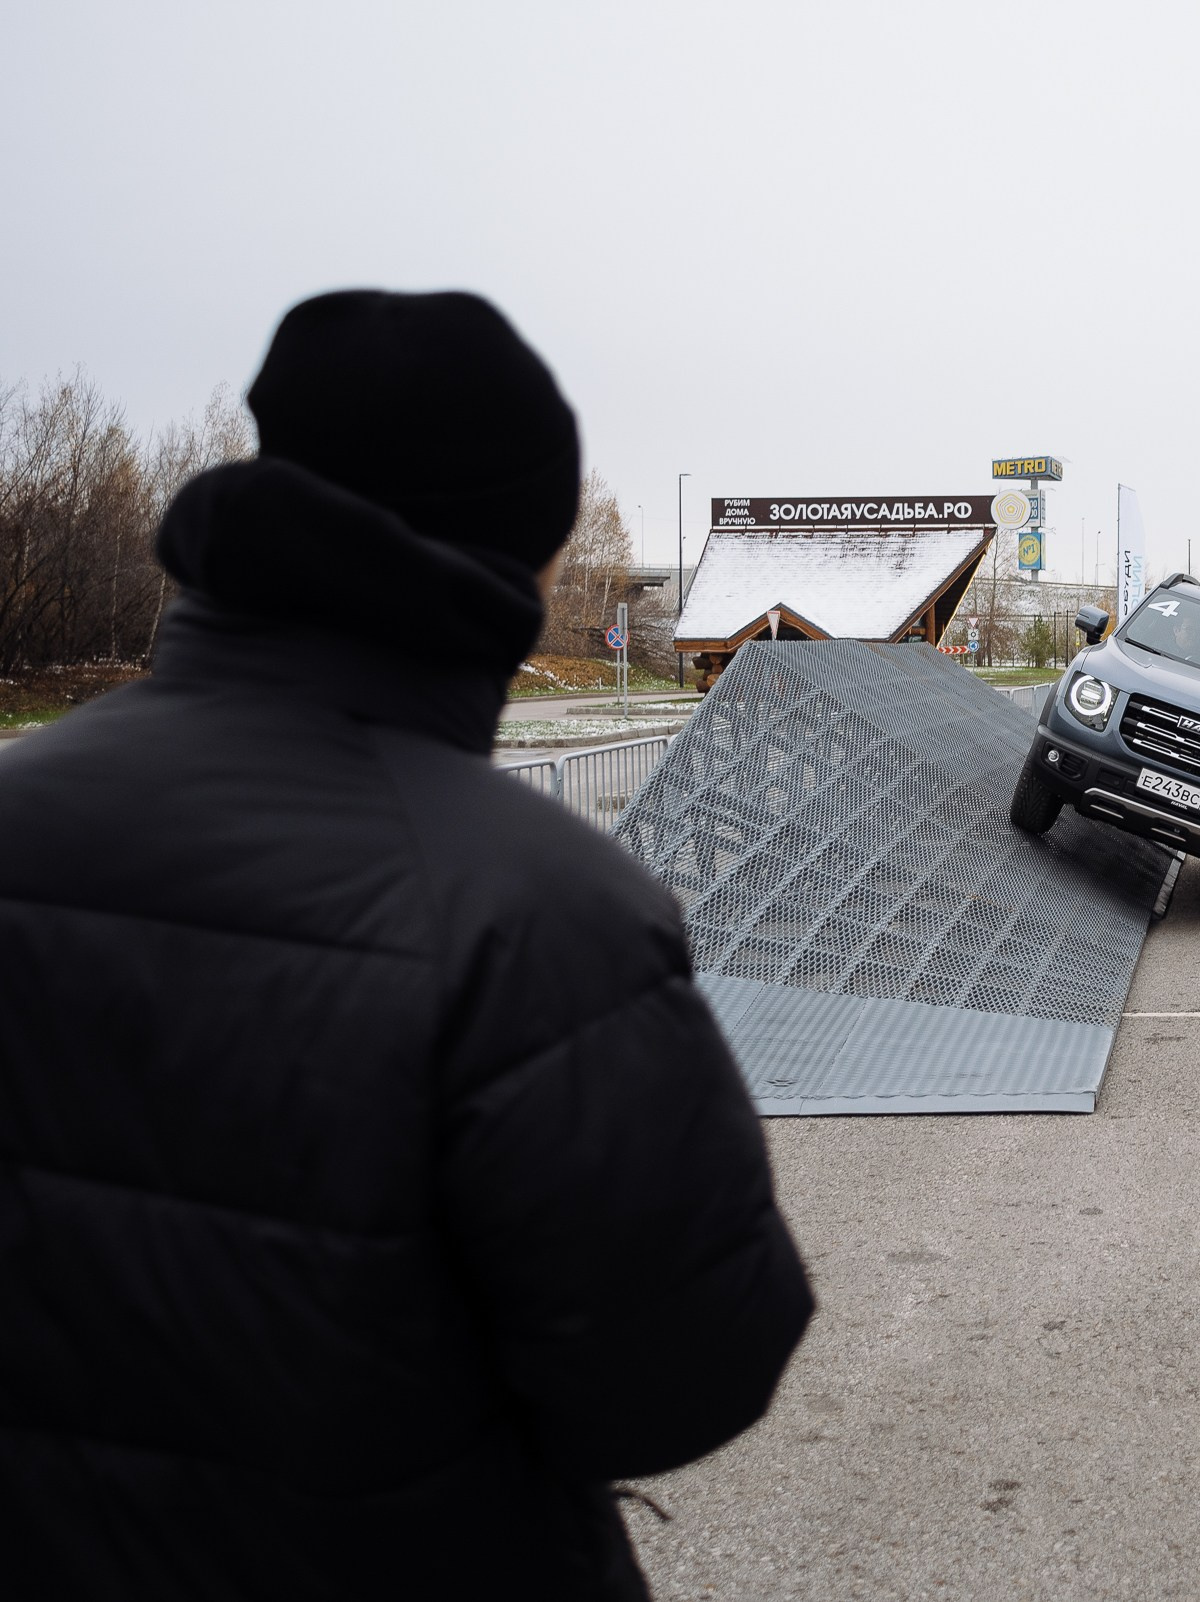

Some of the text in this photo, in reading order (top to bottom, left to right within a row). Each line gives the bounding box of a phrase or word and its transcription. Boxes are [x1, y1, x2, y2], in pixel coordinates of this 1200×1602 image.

[993, 458, 1046, 476] METRO
[725, 499, 750, 507] РУБИМ
[725, 508, 749, 516] ДОМА
[769, 502, 972, 521] ЗОЛОТАЯУСАДЬБА.РФ
[719, 517, 755, 525] ВРУЧНУЮ
[1147, 600, 1180, 617] 4
